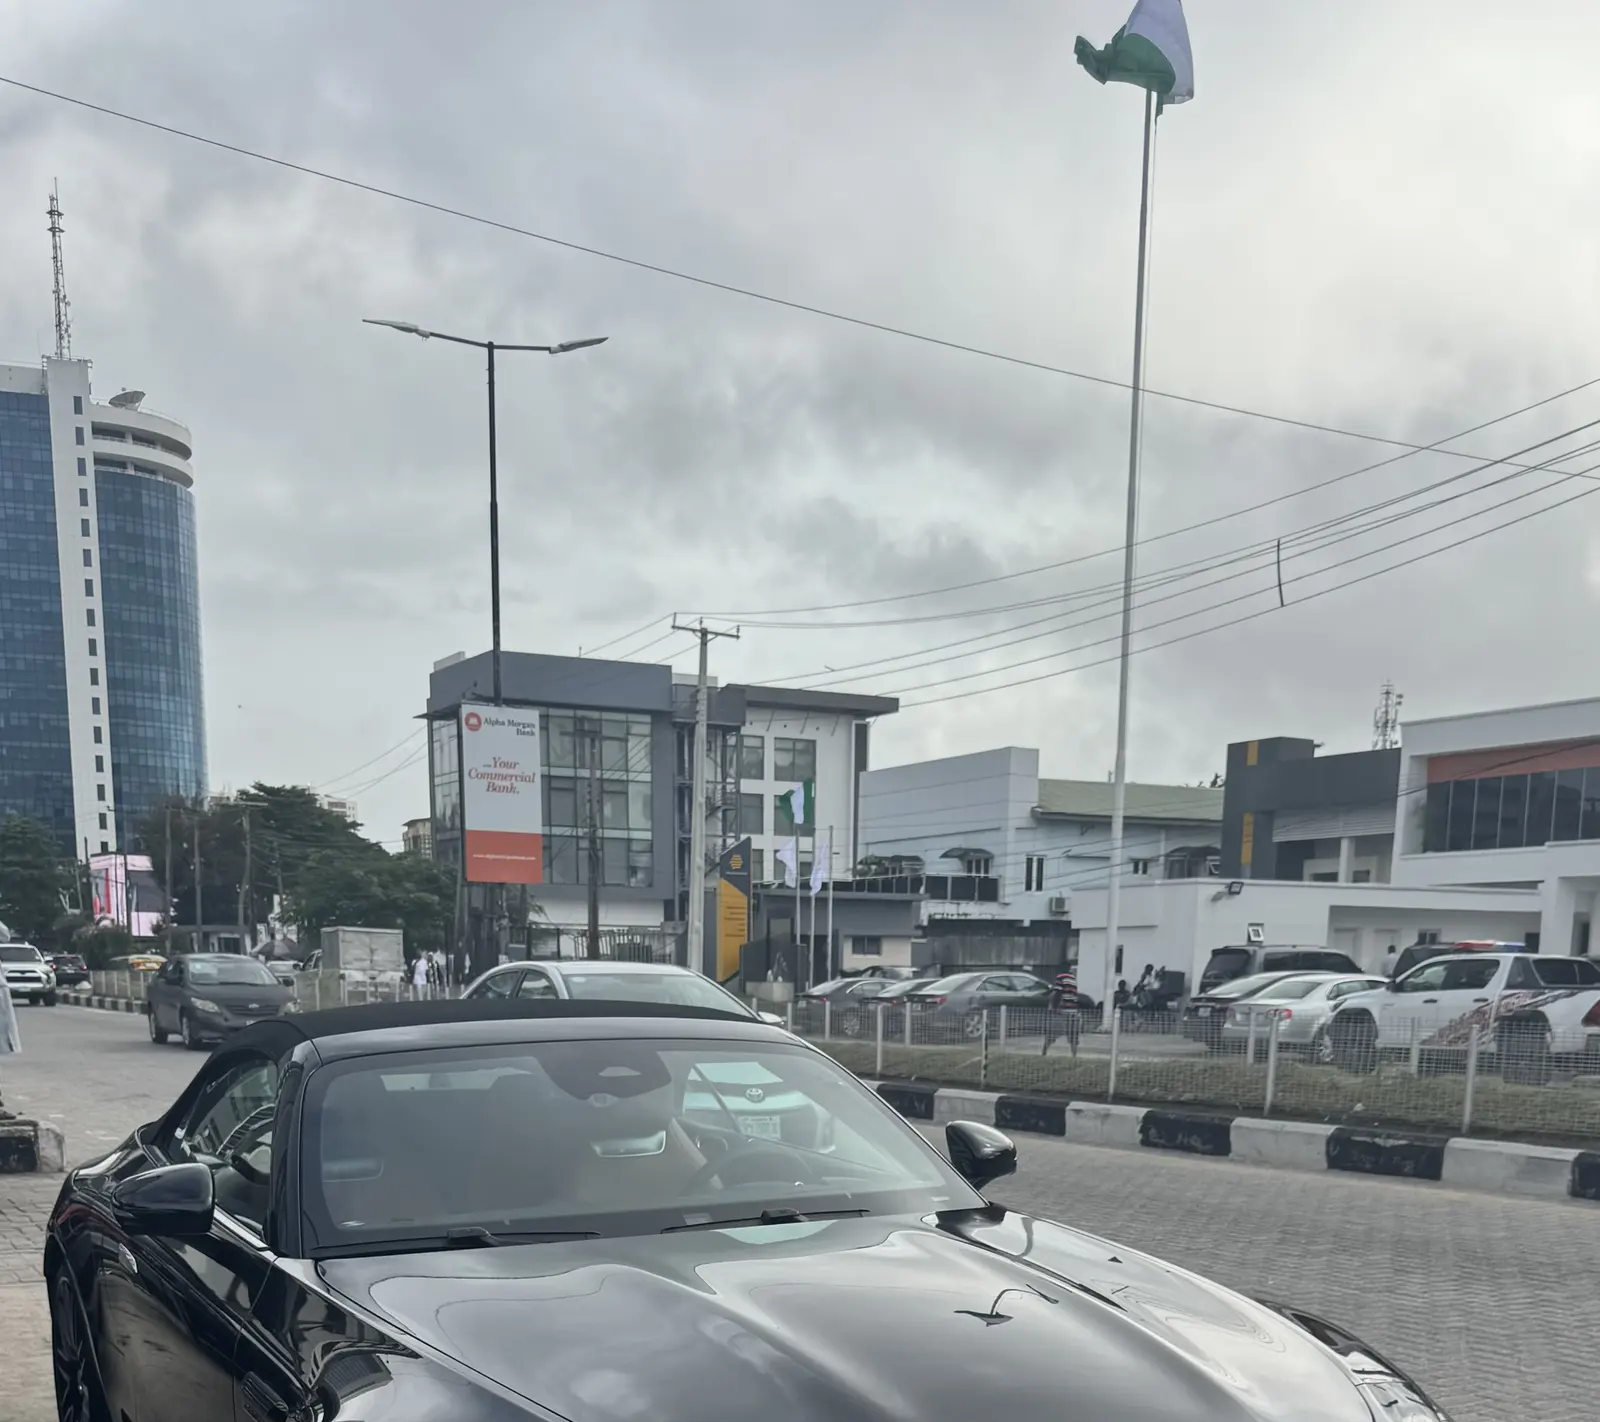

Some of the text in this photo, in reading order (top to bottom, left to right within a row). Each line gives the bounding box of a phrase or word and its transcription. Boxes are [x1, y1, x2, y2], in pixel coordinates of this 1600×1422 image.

[484, 718, 536, 729] Alpha Morgan
[516, 728, 535, 737] Bank
[468, 768, 536, 783] Commercial
[486, 782, 520, 794] Bank.
